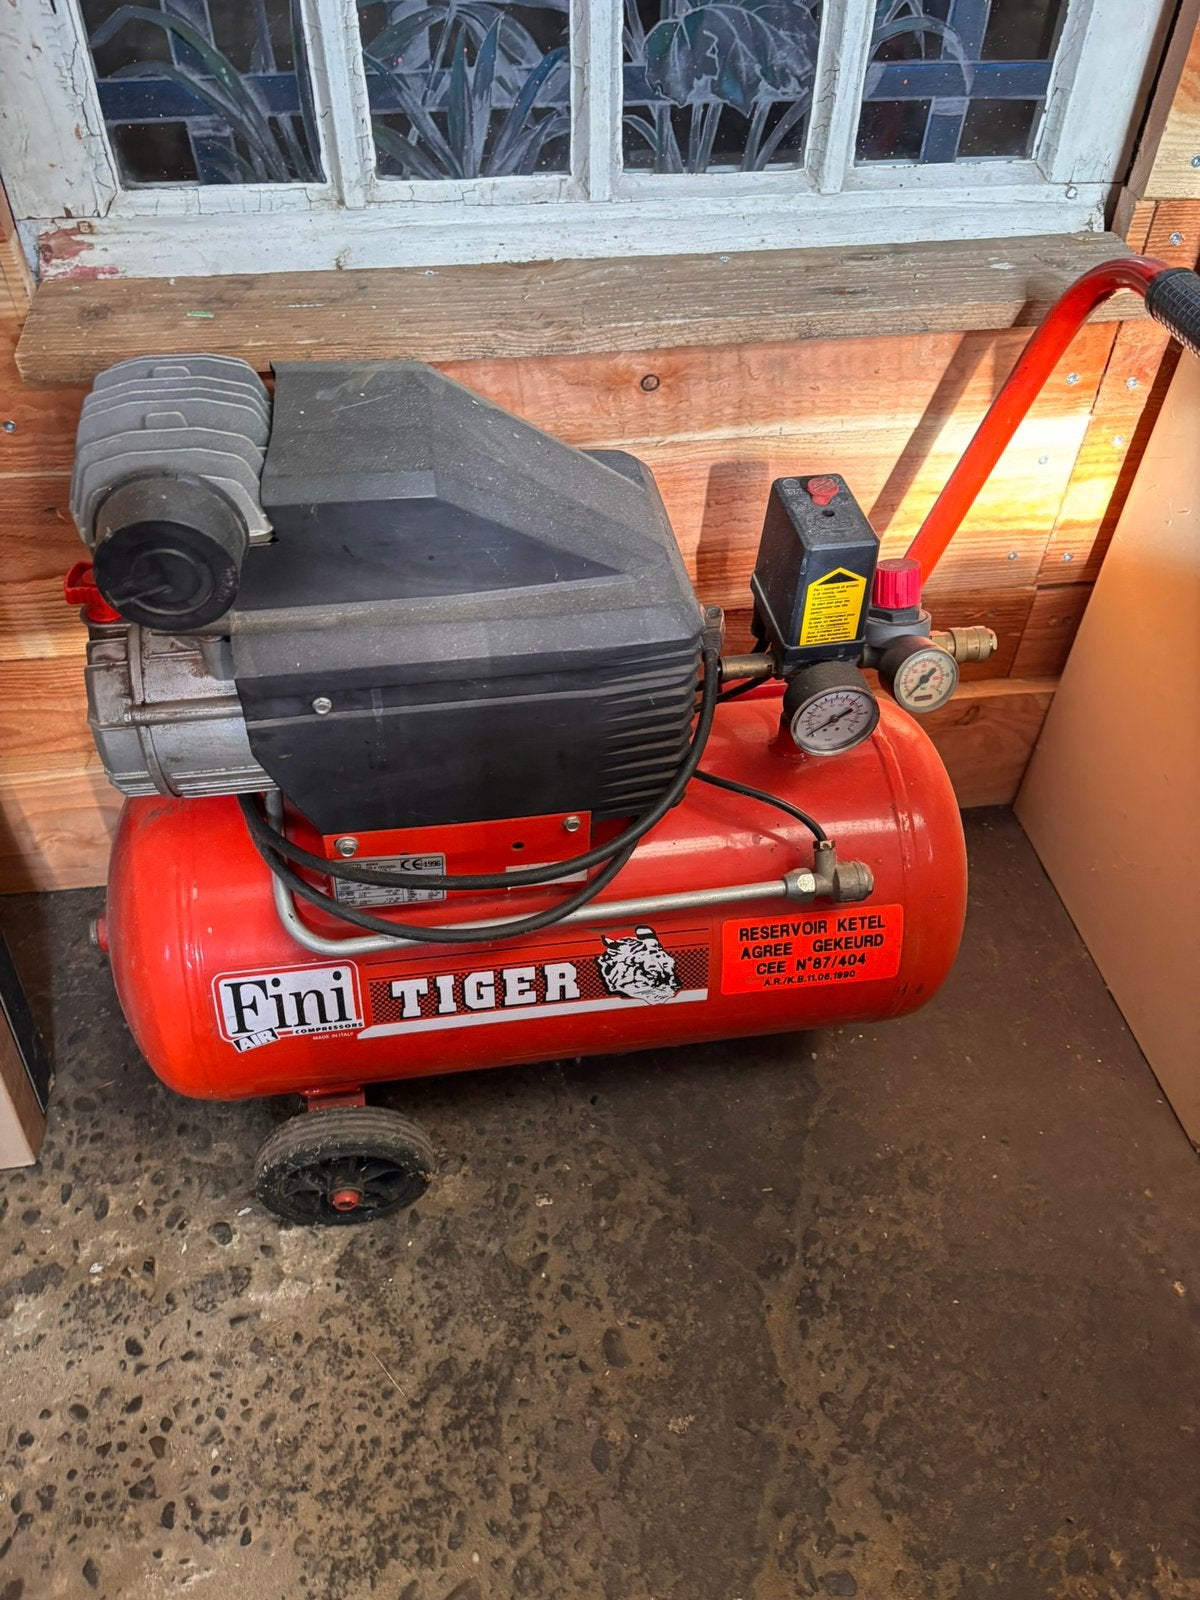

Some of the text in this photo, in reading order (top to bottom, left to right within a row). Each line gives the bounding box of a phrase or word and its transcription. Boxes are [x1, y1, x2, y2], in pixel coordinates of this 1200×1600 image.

[738, 915, 886, 942] RESERVOIR KETEL
[741, 933, 884, 960] AGREE GEKEURD
[756, 960, 786, 975] CEE
[391, 962, 581, 1018] TIGER
[224, 971, 353, 1034] Fini
[237, 1029, 277, 1051] AIR
[295, 1022, 363, 1035] COMPRESSORS
[337, 1032, 355, 1040] ITALY
